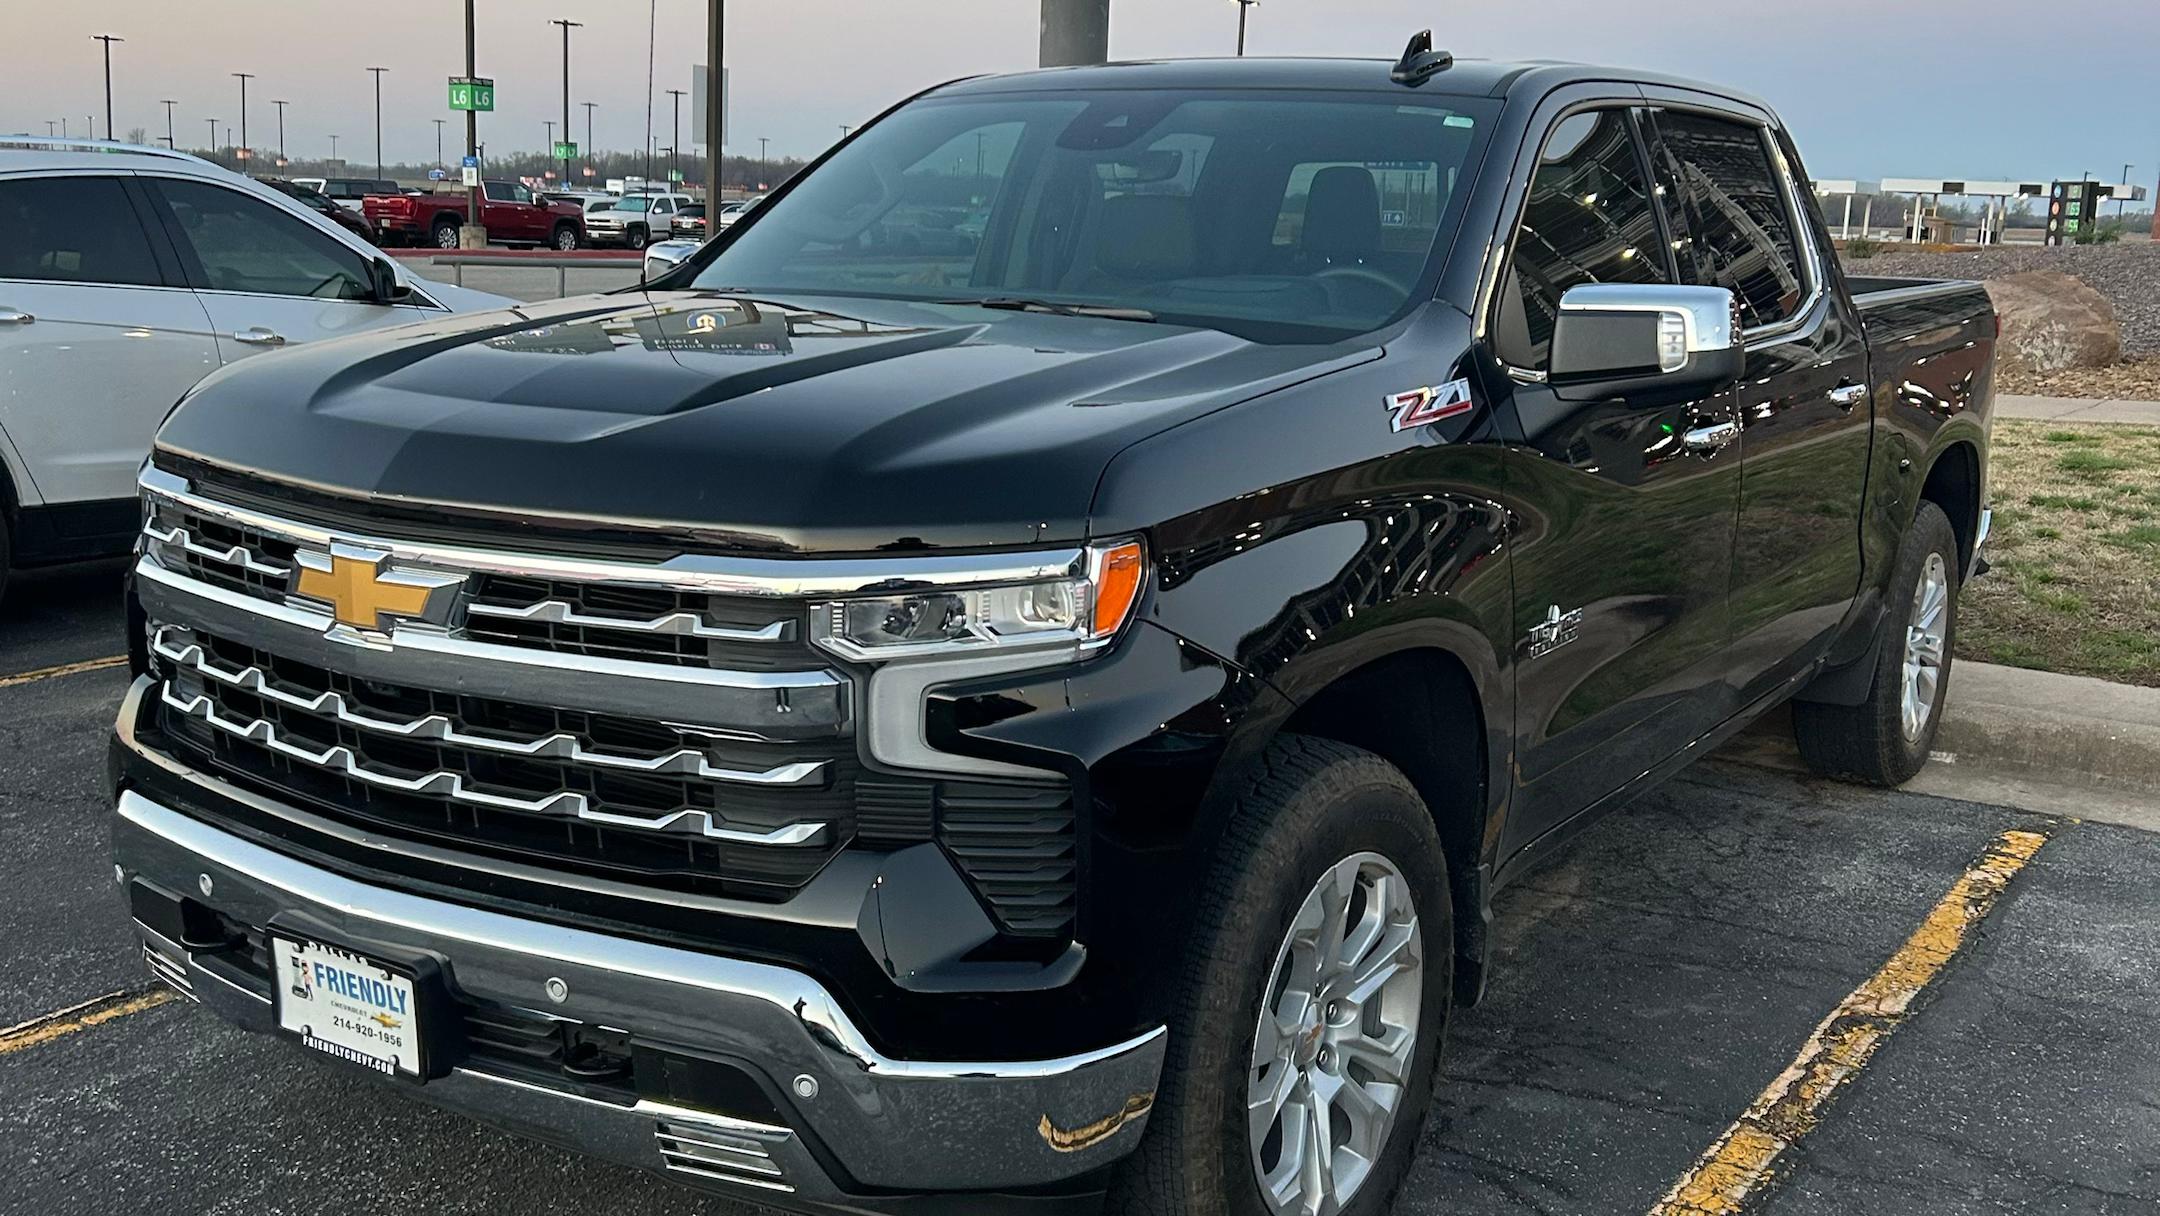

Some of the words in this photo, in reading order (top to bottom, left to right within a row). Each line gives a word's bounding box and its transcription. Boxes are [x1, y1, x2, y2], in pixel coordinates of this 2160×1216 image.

[453, 90, 466, 105] L6
[475, 91, 489, 106] L6
[314, 962, 407, 1015] FRIENDLY
[333, 1016, 402, 1047] 214-920-1956
[303, 1035, 395, 1076] FRIENDLYCHEVY.COM
